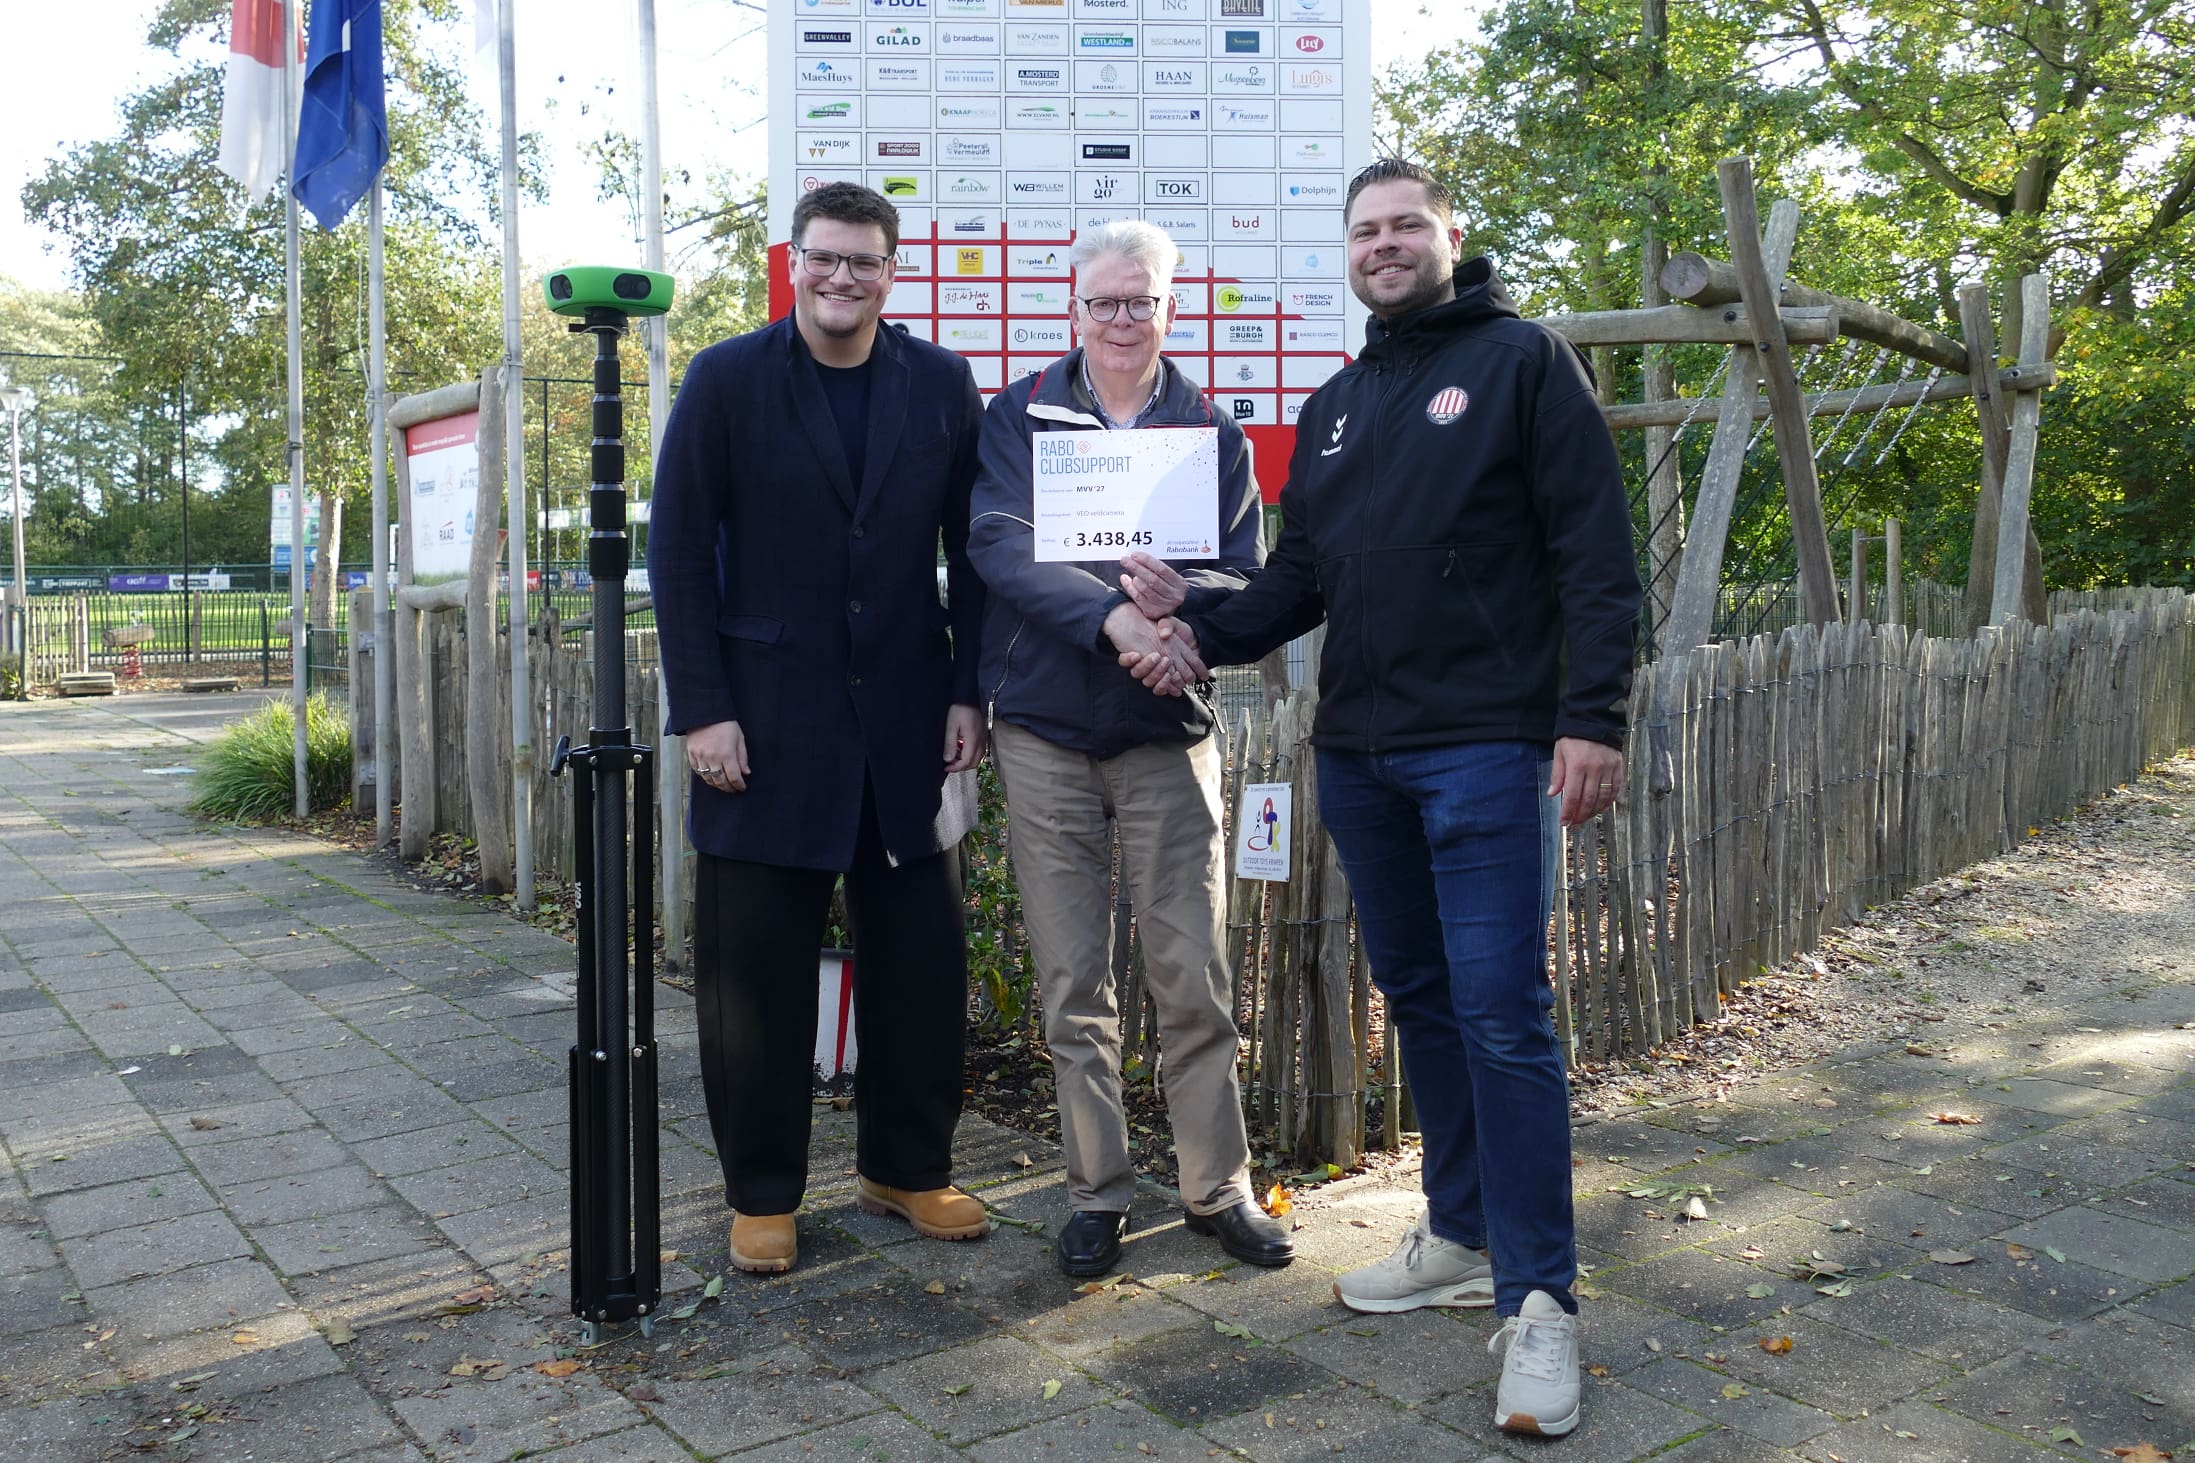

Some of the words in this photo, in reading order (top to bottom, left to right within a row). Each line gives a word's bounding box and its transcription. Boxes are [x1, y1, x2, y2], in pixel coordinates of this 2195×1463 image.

[805, 33, 850, 41] GREENVALLEY
[953, 34, 994, 42] braadbaas
[801, 72, 853, 84] MaesHuys
[1156, 71, 1193, 80] HAAN
[1238, 112, 1269, 120] Huisman
[833, 140, 851, 149] DIJK
[951, 183, 988, 193] rainbow
[1159, 183, 1192, 194] TOK
[1301, 186, 1337, 196] Dolphijn
[1232, 215, 1260, 228] bud
[1228, 293, 1273, 302] Rofraline
[1030, 330, 1063, 340] kroes
[1040, 440, 1074, 457] RABO
[1040, 455, 1132, 475] CLUBSUPPORT
[1076, 531, 1153, 547] 3.438,45
